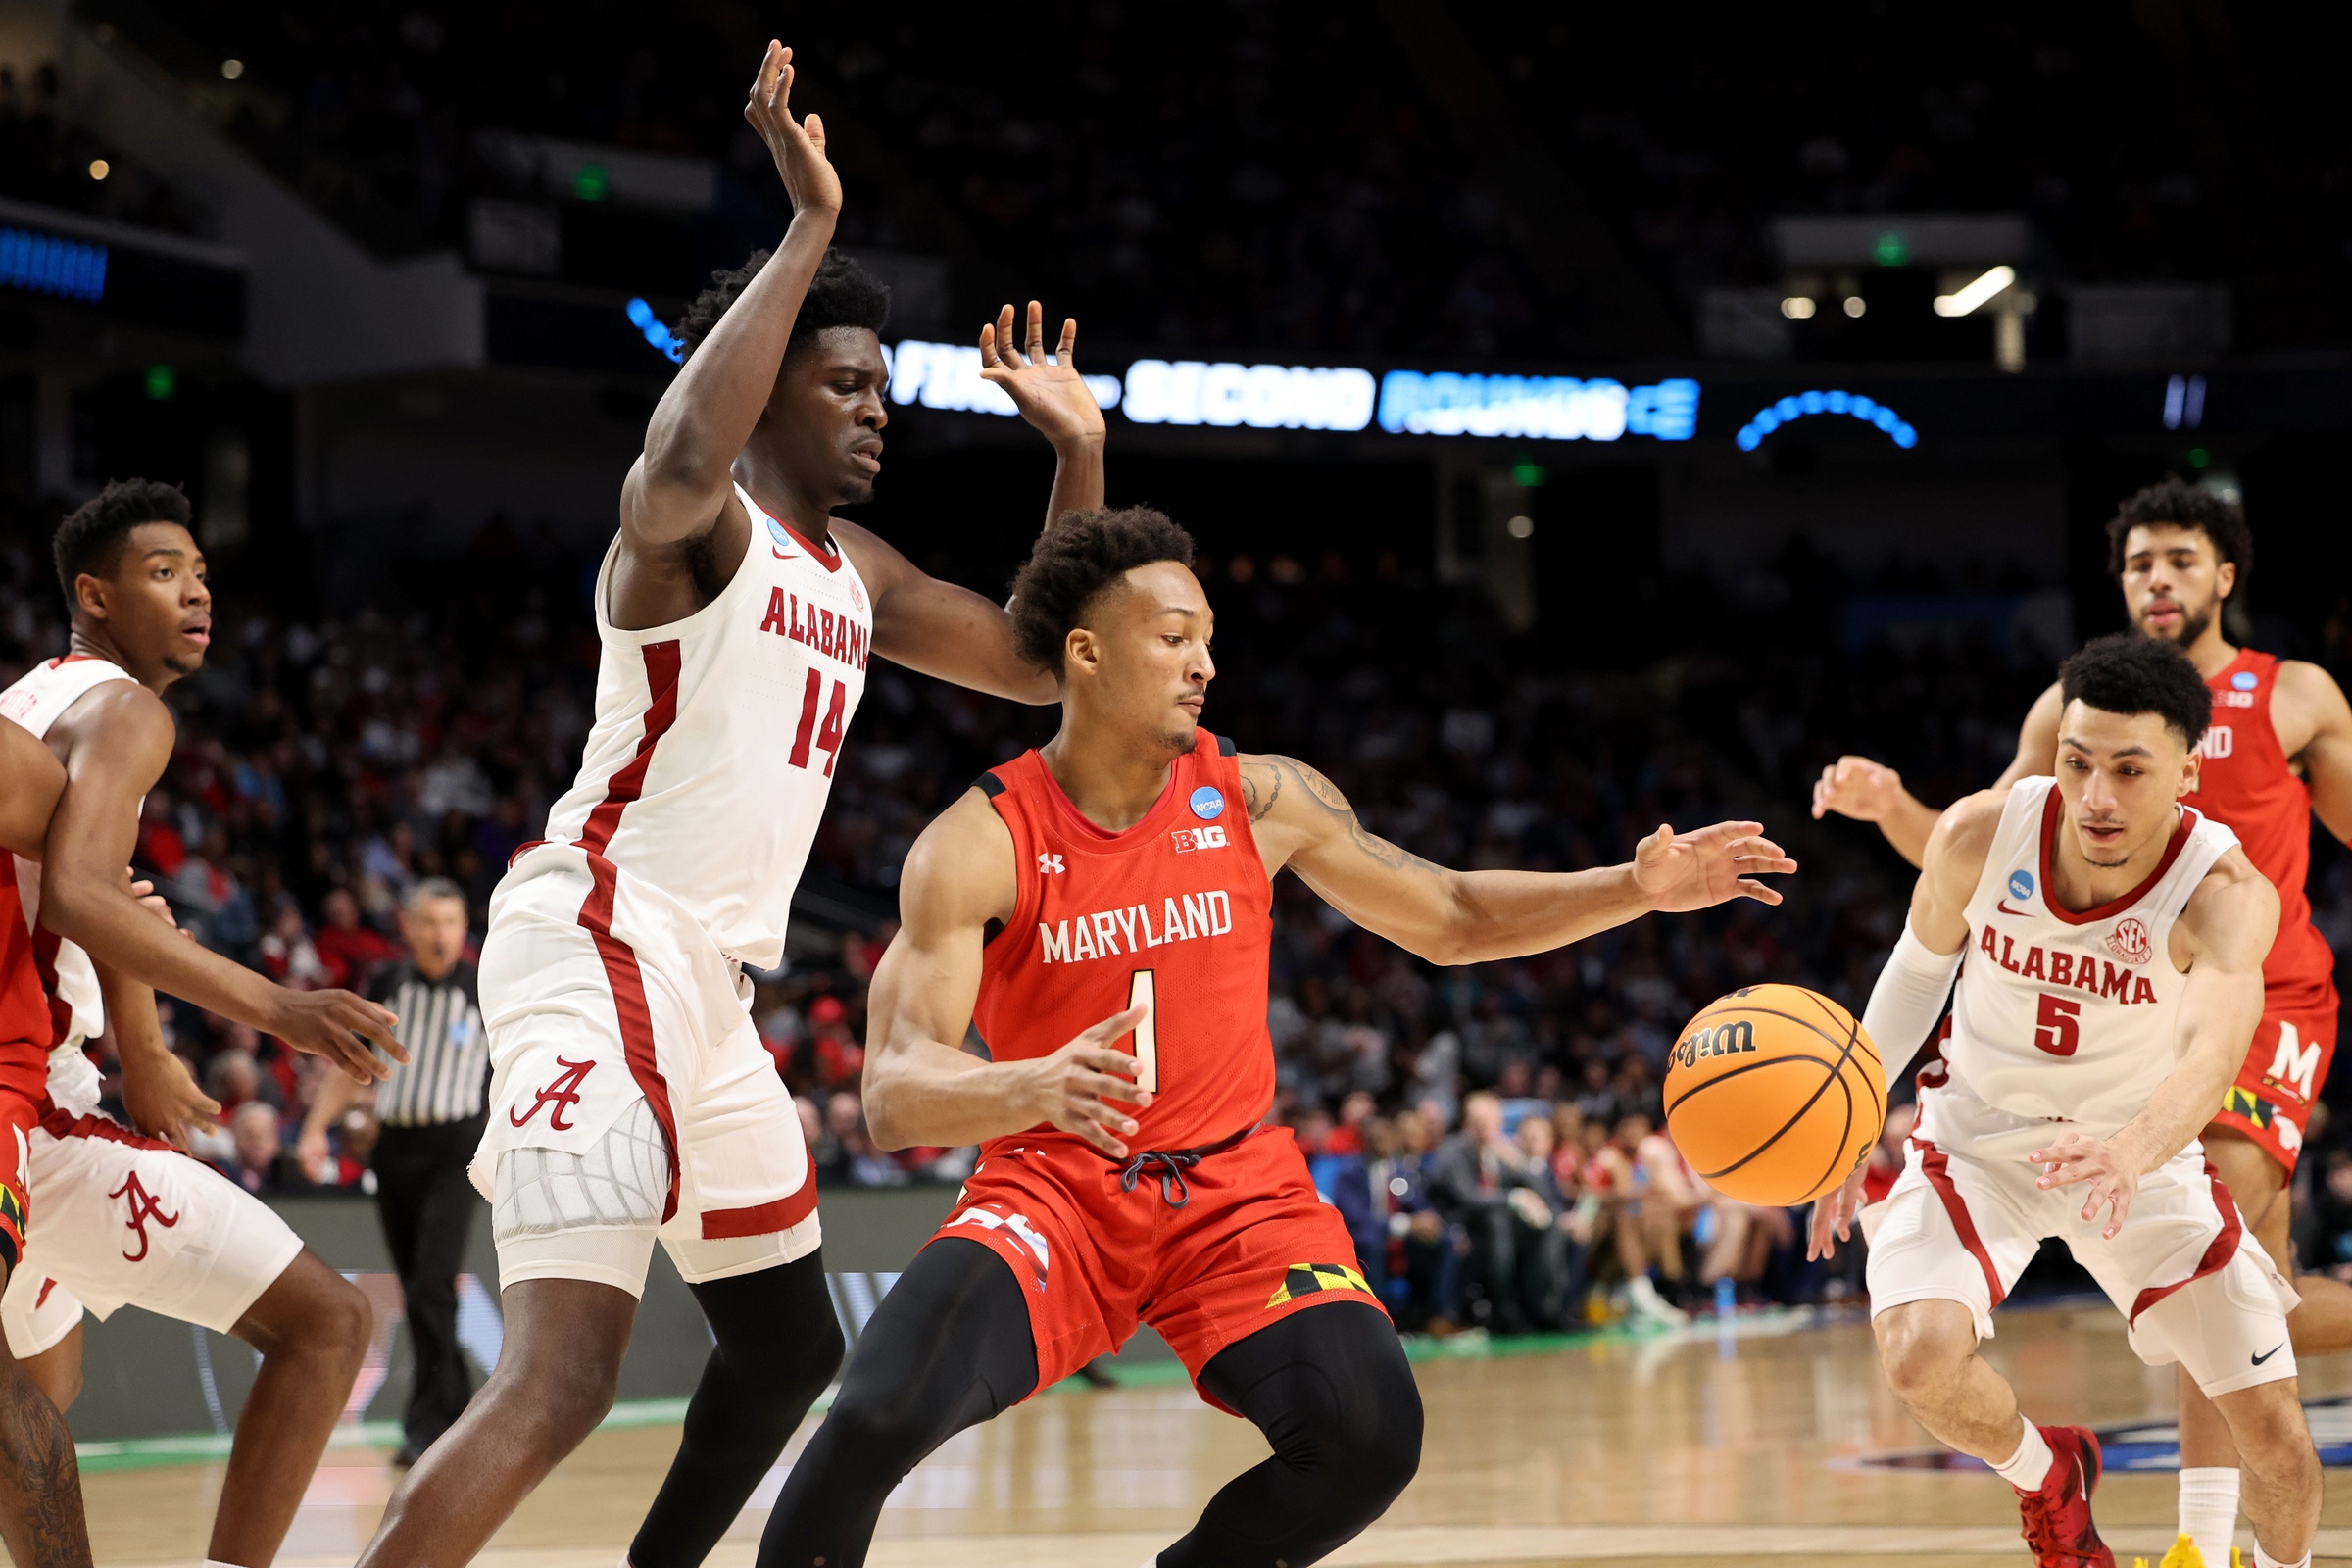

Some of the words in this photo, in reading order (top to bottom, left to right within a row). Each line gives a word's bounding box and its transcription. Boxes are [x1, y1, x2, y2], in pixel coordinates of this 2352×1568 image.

[788, 667, 846, 779] 14
[1196, 799, 1223, 812] NCAA
[1039, 890, 1233, 964] MARYLAND
[1981, 925, 2158, 1004] ALABAMA
[2117, 919, 2146, 954] SEC
[1127, 968, 1158, 1094] 1
[1666, 1020, 1756, 1074] Wilso
[2034, 993, 2081, 1057] 5
[2266, 1020, 2322, 1102] M
[510, 1054, 597, 1131] A
[108, 1170, 179, 1262] A
